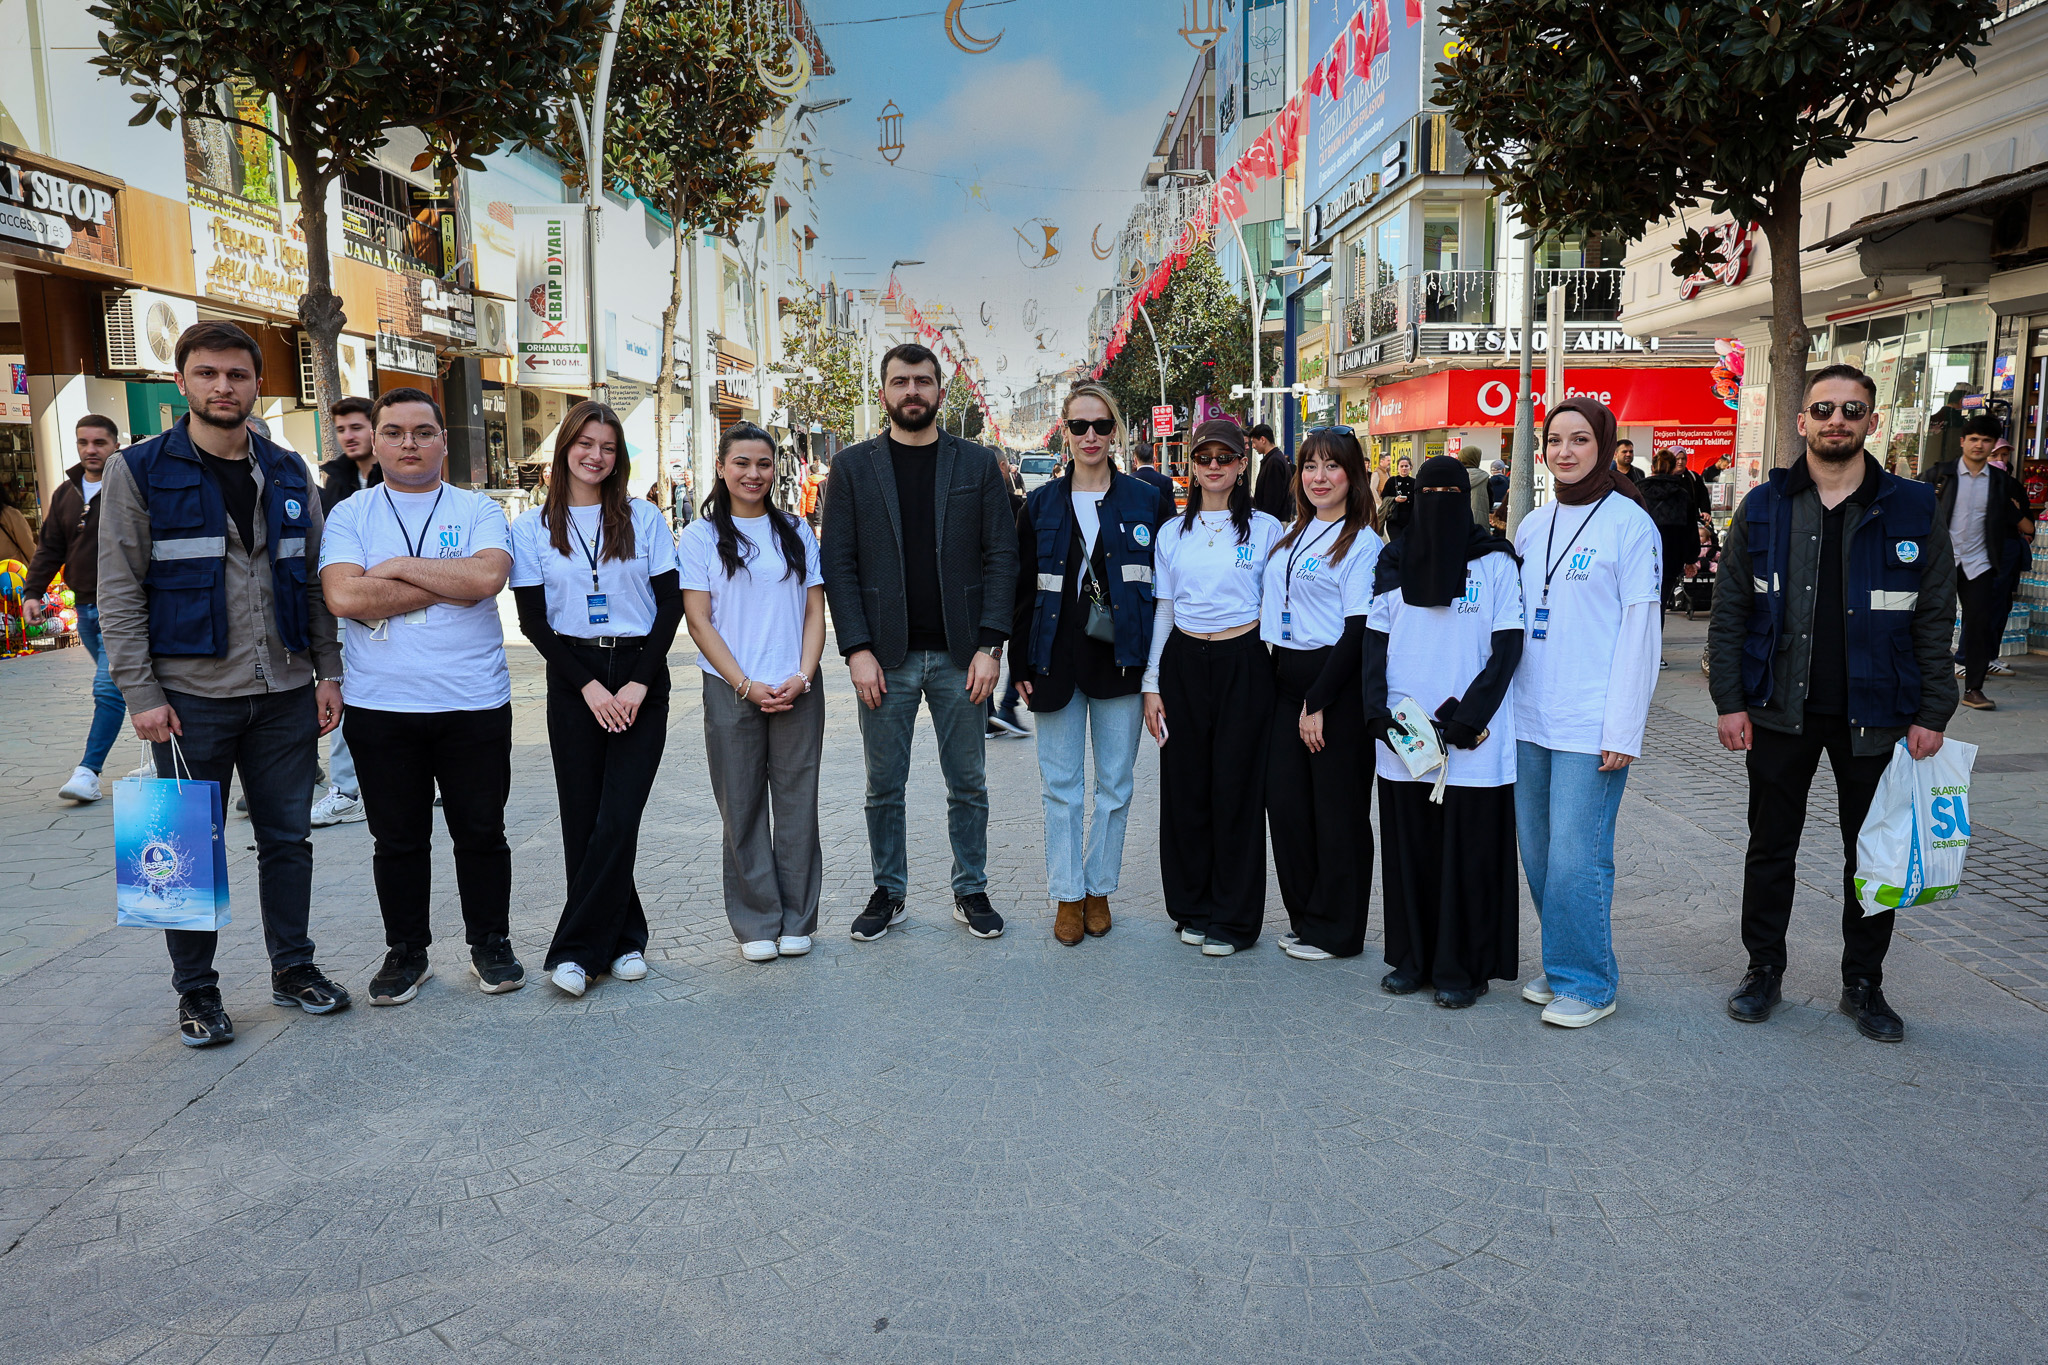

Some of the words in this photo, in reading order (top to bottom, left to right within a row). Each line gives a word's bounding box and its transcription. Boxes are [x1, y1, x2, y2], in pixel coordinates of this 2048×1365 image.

[1250, 66, 1282, 91] SAY
[30, 170, 113, 226] SHOP
[344, 235, 384, 268] UANA
[526, 344, 557, 352] ORHAN
[557, 344, 581, 353] USTA
[1448, 331, 1479, 351] BY
[552, 359, 567, 367] 100
[568, 359, 583, 367] Mt.
[1345, 348, 1362, 370] SALON
[1361, 344, 1381, 365] AHMET
[1676, 429, 1713, 438] İhtiyaçlarınıza
[1713, 429, 1734, 437] Yönelik
[1654, 439, 1677, 447] Uygun
[1677, 438, 1703, 446] Faturalı
[1704, 438, 1731, 446] Teklifler
[439, 531, 459, 548] SU
[1236, 546, 1253, 562] SU
[1570, 553, 1592, 571] SU
[1301, 557, 1321, 572] SU
